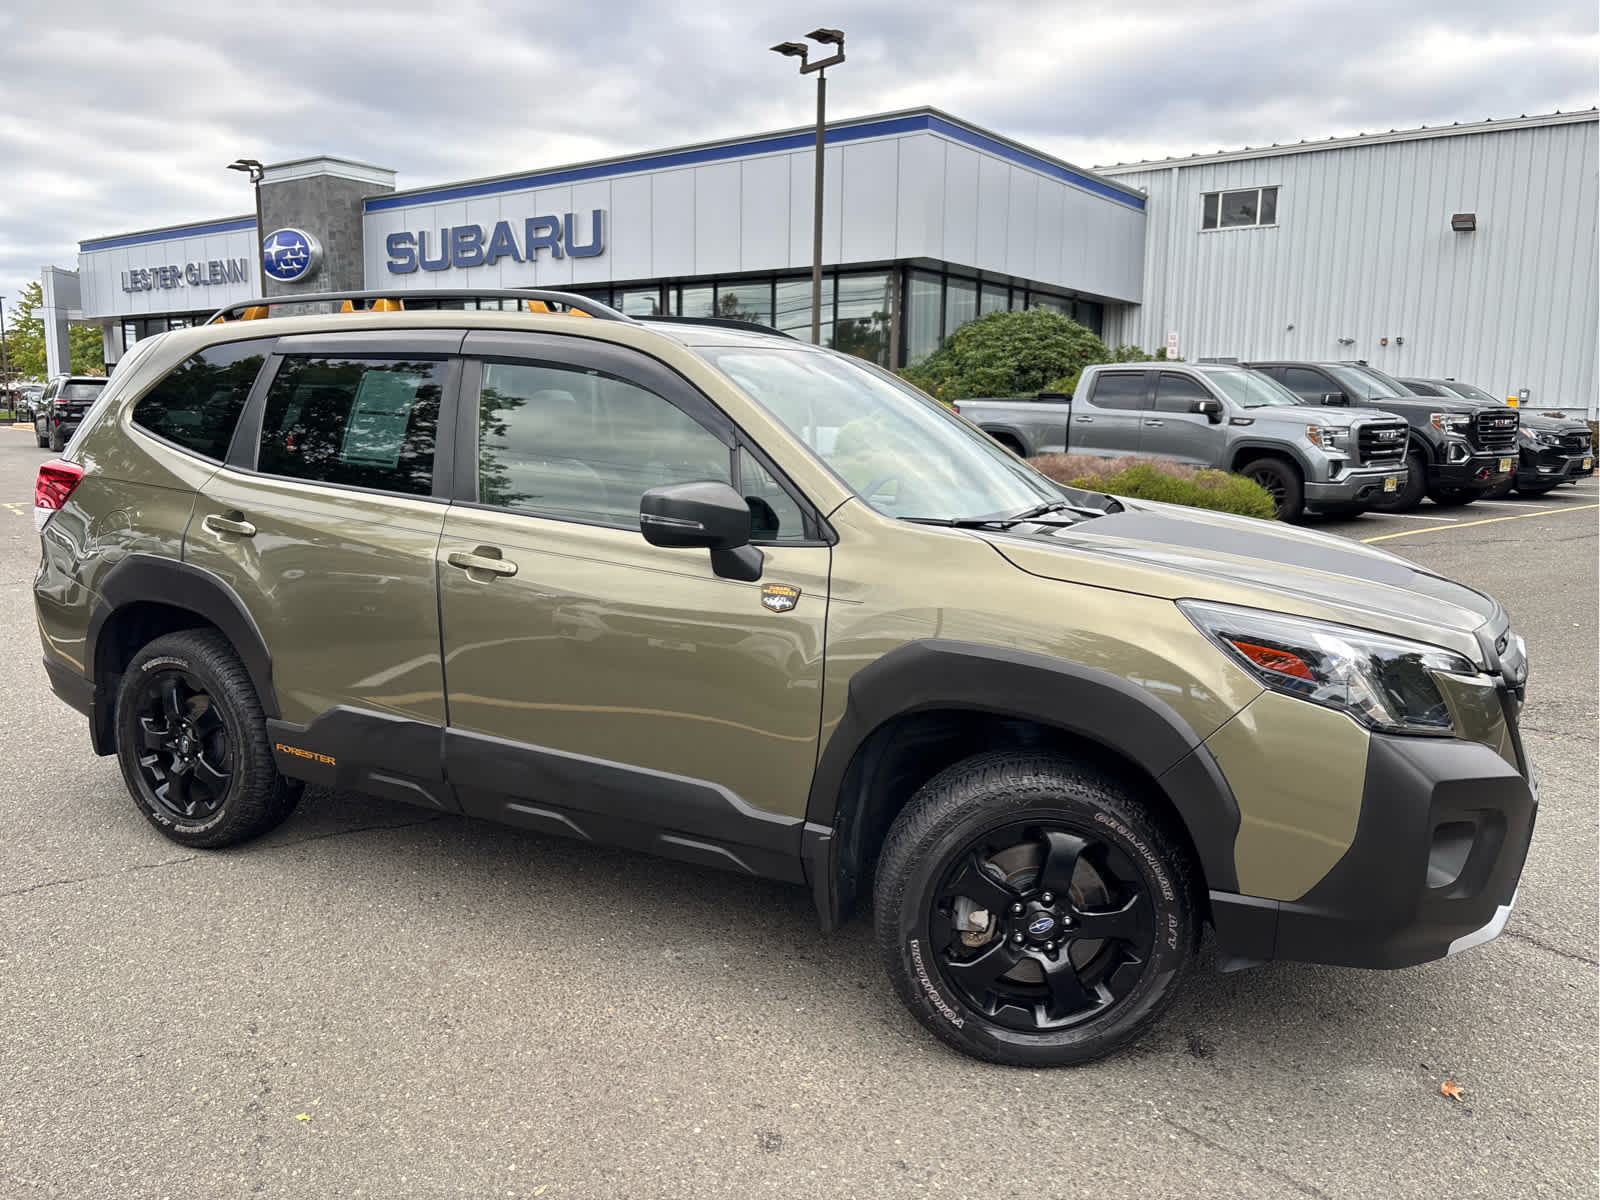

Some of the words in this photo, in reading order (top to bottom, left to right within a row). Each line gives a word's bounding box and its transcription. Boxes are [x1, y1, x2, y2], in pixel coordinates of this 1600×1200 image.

[386, 209, 606, 274] SUBARU
[120, 265, 184, 293] LESTER
[185, 258, 248, 286] GLENN
[275, 743, 337, 766] FORESTER
